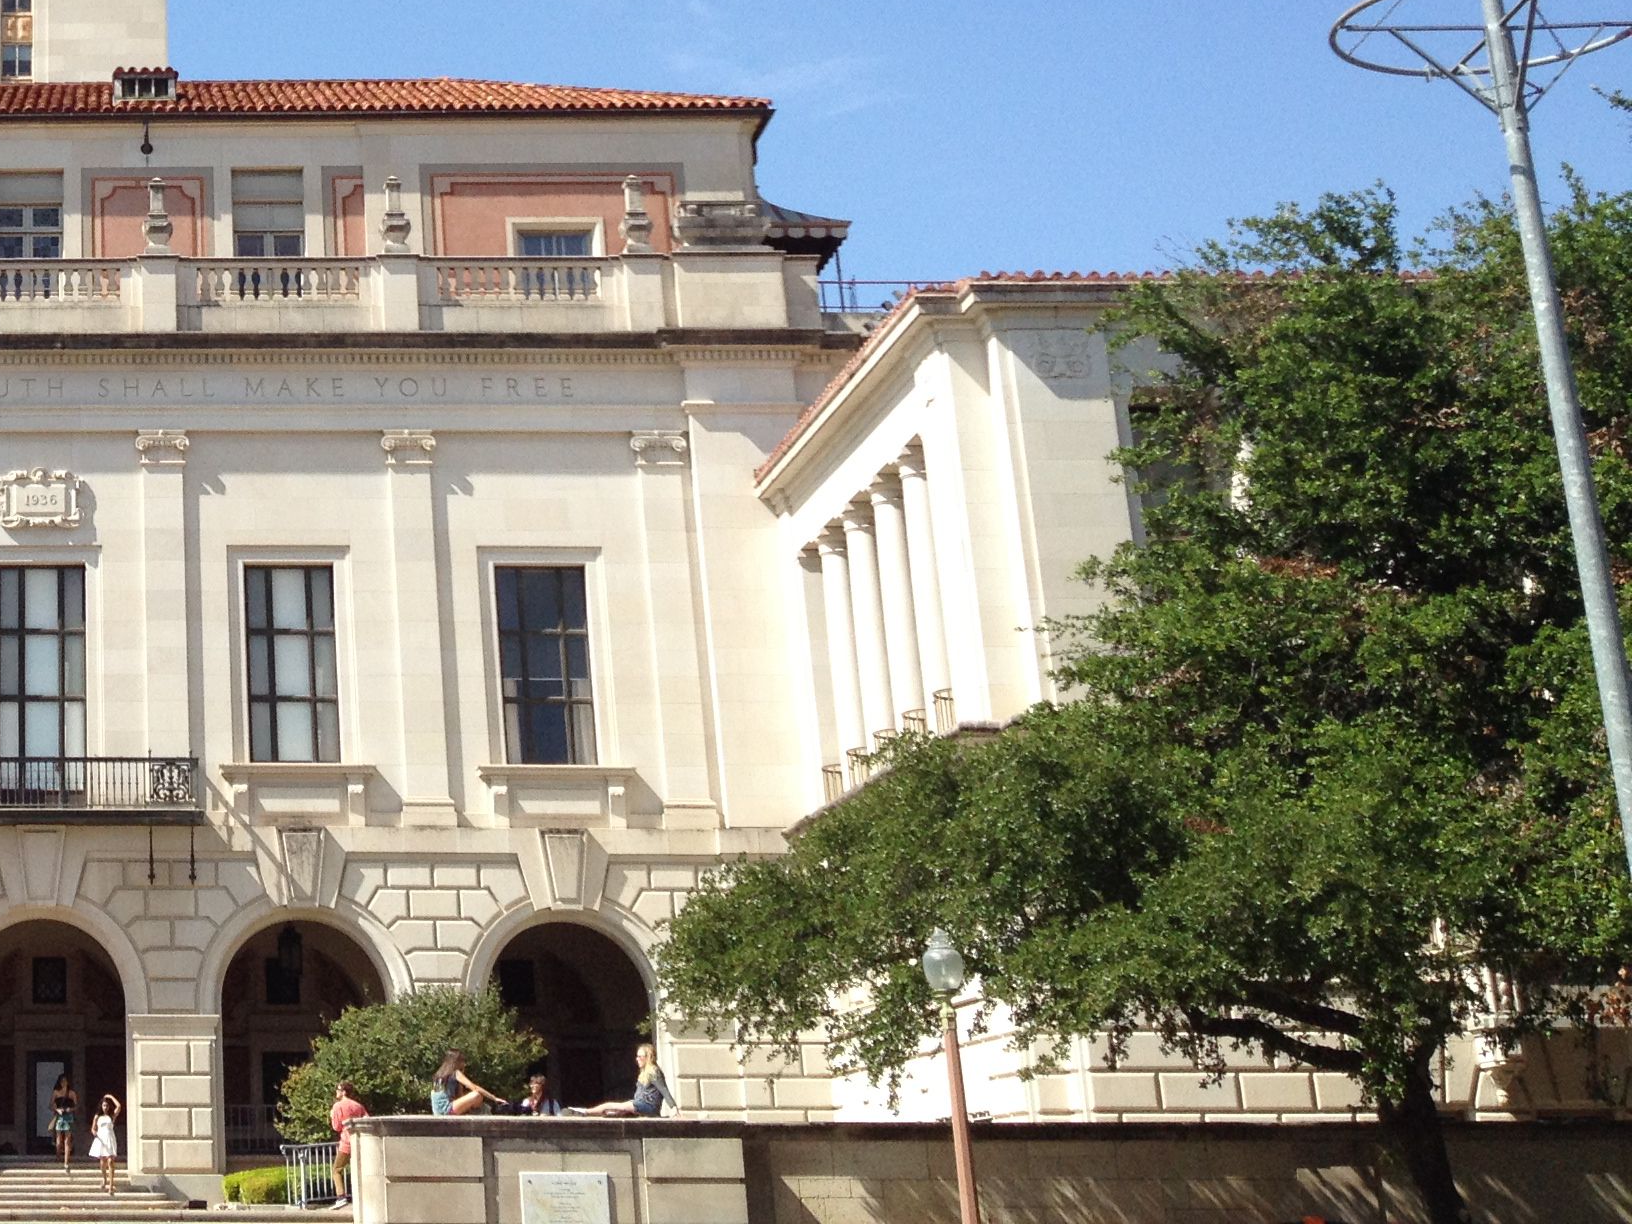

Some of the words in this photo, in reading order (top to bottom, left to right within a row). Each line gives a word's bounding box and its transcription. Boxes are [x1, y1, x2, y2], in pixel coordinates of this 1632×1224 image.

[98, 378, 216, 398] SHALL
[244, 377, 345, 398] MAKE
[375, 377, 447, 398] YOU
[480, 377, 575, 398] FREE
[25, 494, 58, 507] 1936
